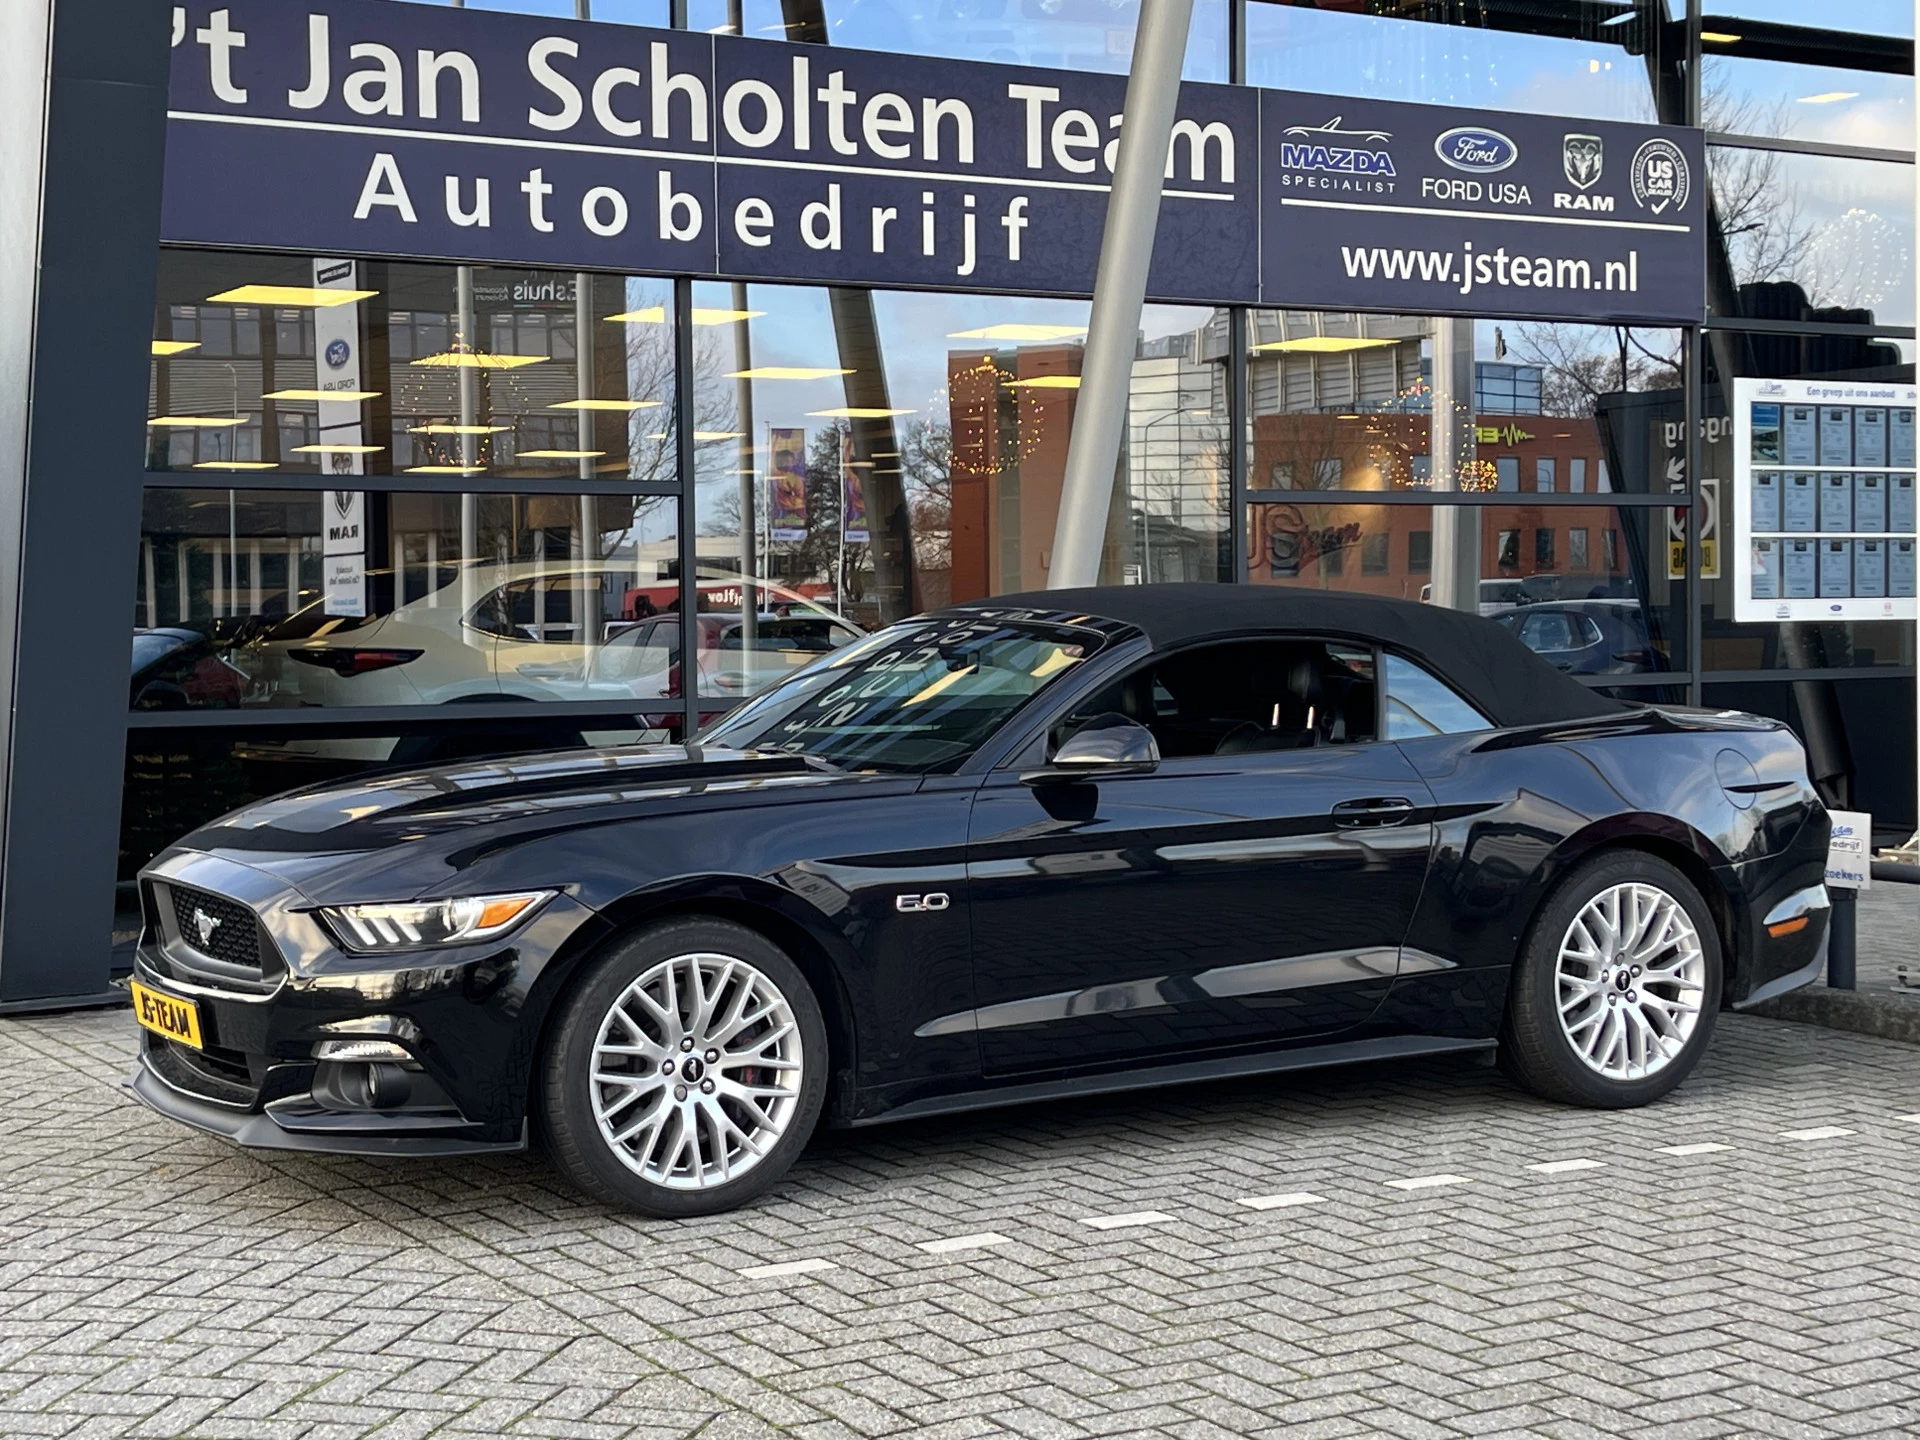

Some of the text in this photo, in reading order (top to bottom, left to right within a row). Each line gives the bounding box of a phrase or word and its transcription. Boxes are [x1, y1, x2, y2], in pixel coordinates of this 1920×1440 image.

[289, 15, 480, 128] Jan
[528, 37, 974, 163] Scholten
[1281, 142, 1397, 177] MAZDA
[1457, 135, 1500, 165] Ford
[1281, 174, 1396, 193] SPECIALIST
[1648, 160, 1673, 178] US
[1648, 178, 1673, 189] CAR
[1422, 178, 1532, 205] FORD USA
[1554, 193, 1615, 212] RAM
[354, 153, 1029, 276] Autobedrijf
[1341, 242, 1637, 294] www.jsteam.nl
[141, 990, 192, 1039] JS-TEAM
